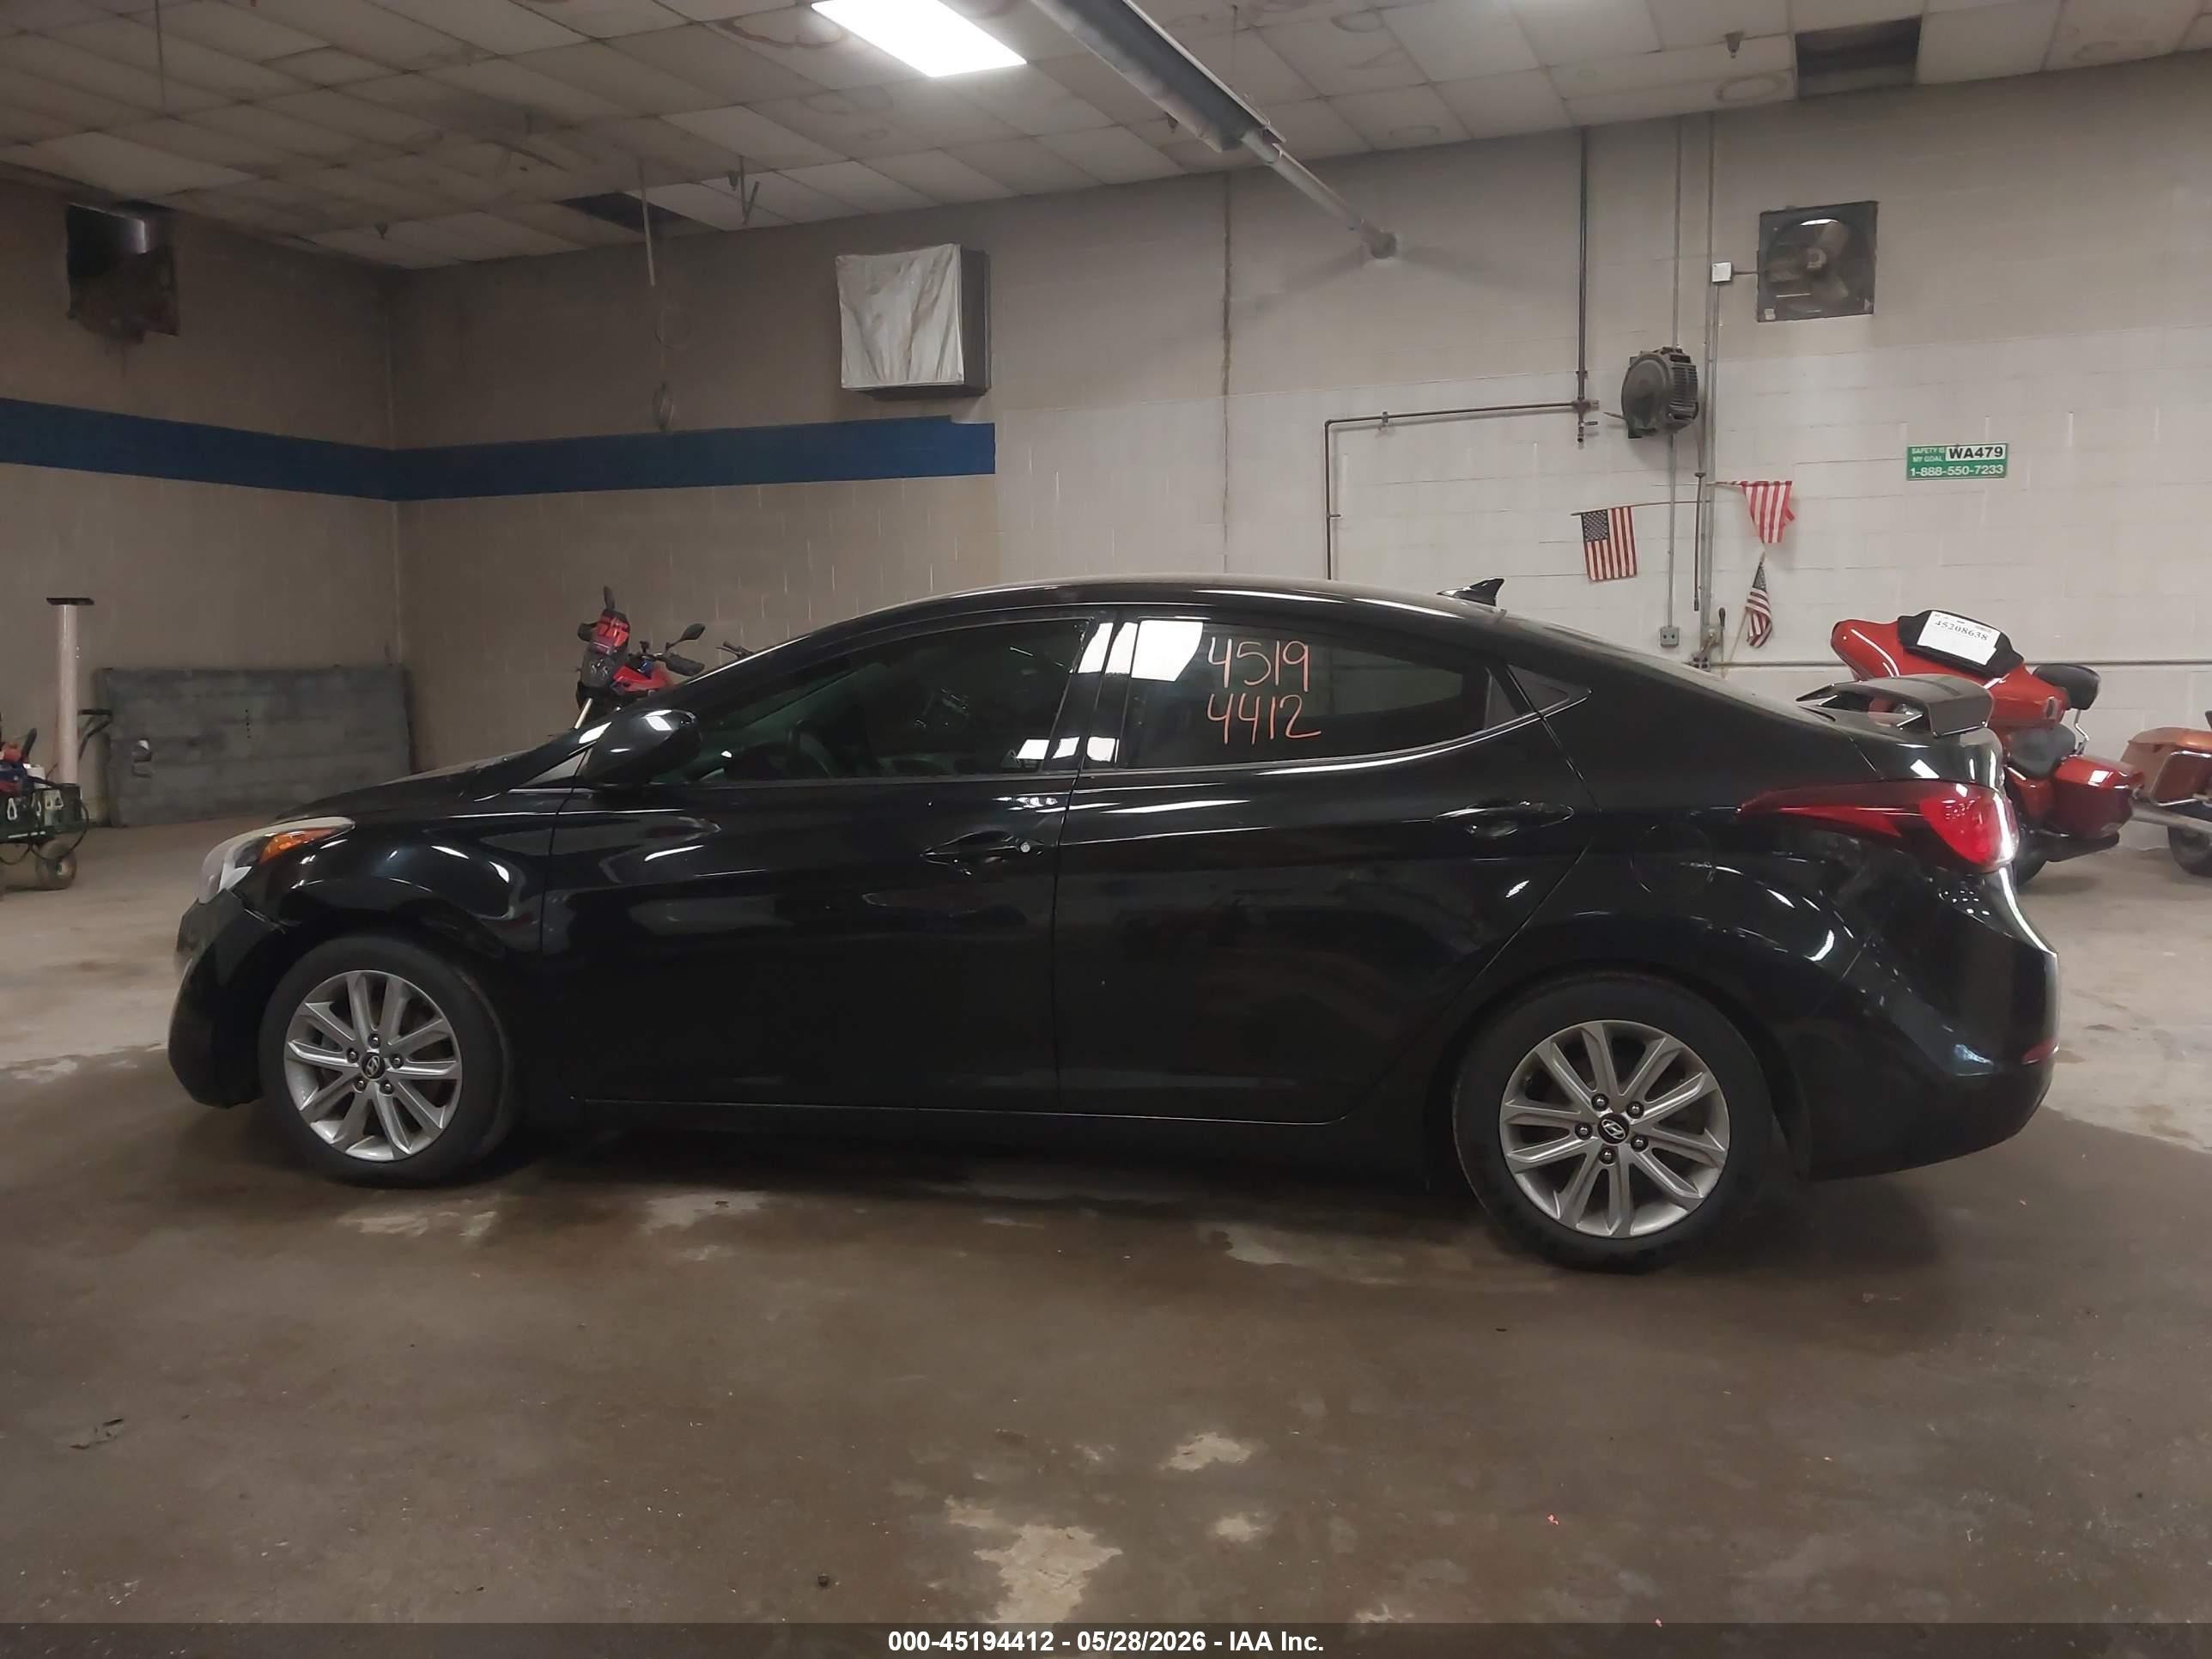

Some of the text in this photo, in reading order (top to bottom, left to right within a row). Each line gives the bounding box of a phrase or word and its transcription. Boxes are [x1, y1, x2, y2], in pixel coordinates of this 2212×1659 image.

[1948, 446, 2003, 459] WA479
[1910, 464, 2004, 477] 1-888-550-7233
[1934, 619, 1989, 641] 45208638
[1207, 636, 1310, 692] 4519
[1206, 693, 1322, 745] 4412
